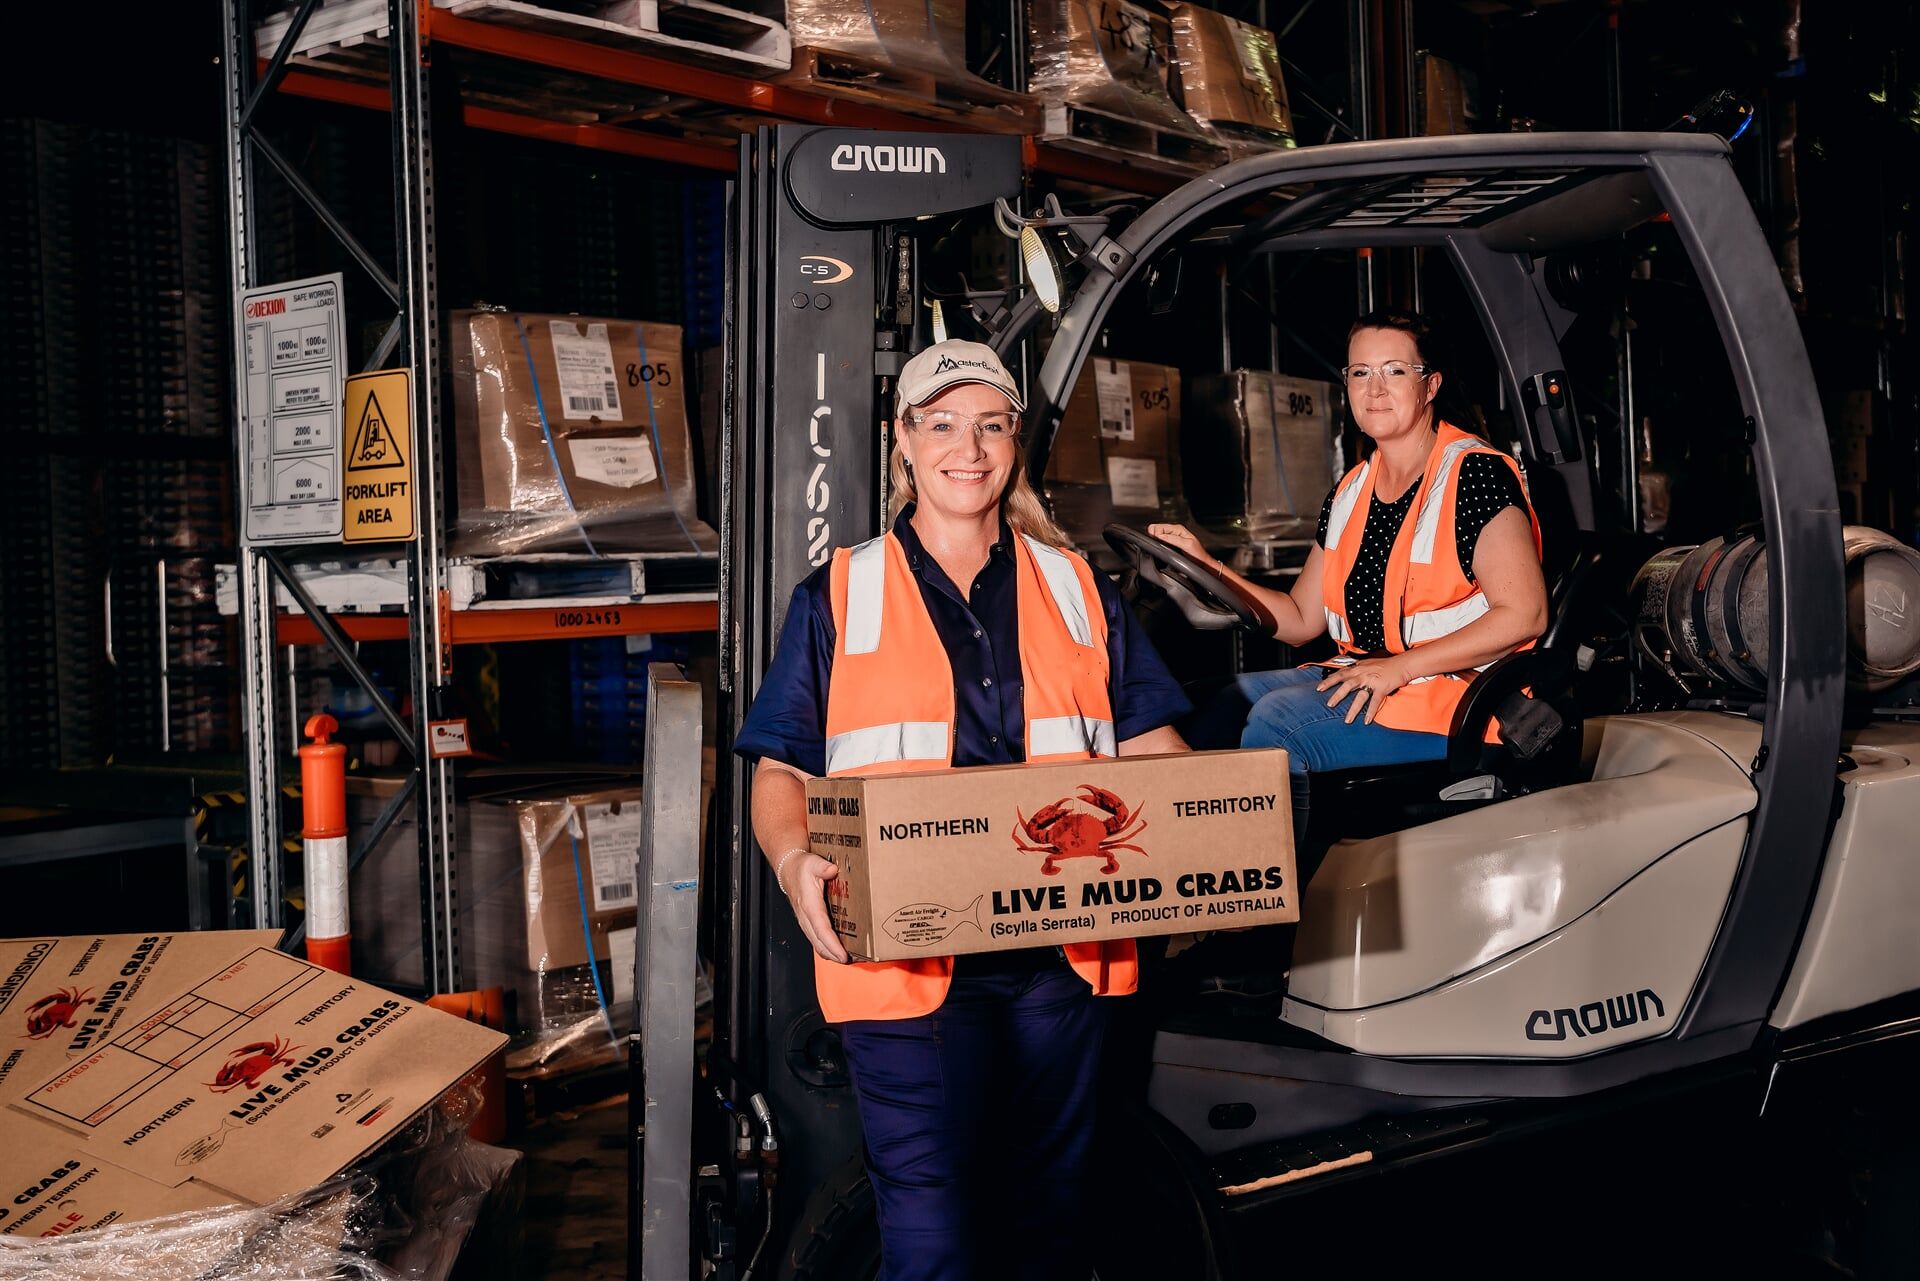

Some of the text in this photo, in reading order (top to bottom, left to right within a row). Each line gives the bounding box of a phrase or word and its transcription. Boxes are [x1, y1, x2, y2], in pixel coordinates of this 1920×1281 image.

[831, 144, 946, 173] CROWN
[293, 288, 335, 302] SAFE WORKING
[317, 297, 335, 307] LOADS
[255, 298, 286, 317] DEXION
[278, 340, 293, 350] 1000
[306, 336, 321, 346] 1000
[626, 364, 672, 387] 805
[1288, 391, 1314, 416] 805
[296, 426, 311, 436] 2000
[296, 478, 311, 488] 6000
[346, 481, 408, 501] FORKLIFT
[357, 508, 393, 525] AREA
[808, 797, 821, 815] LIVE
[839, 797, 860, 816] CRABS
[1173, 794, 1277, 818] TERRITORY
[880, 817, 990, 841] NORTHERN
[992, 866, 1284, 915] LIVE MUD CRABS
[1111, 896, 1286, 925] PRODUCT OF AUSTRALIA
[990, 914, 1096, 938] (Scylla Serrata)
[69, 938, 105, 977] TERRITORY
[122, 935, 174, 1002] PRODUCT OF AUSTRALIA
[230, 961, 249, 976] NET
[68, 1018, 104, 1050] LIVE
[93, 980, 128, 1013] MUD
[120, 936, 160, 976] CRABS
[295, 985, 357, 1027] TERRITORY
[1525, 989, 1665, 1041] CROWN
[140, 1009, 173, 1031] COUNT
[142, 1033, 154, 1041] M
[313, 1004, 413, 1076] PRODUCT OF AUSTRALIA
[229, 1000, 400, 1119] LIVE MUD CRABS
[46, 1064, 90, 1093] PACKED
[246, 1103, 278, 1125] (Scylla
[273, 1079, 312, 1105] Serrata)
[123, 1097, 196, 1146] NORTHERN
[14, 1160, 81, 1205] CRABS
[44, 1167, 100, 1205] TERRITORY
[90, 1210, 117, 1231] DROP
